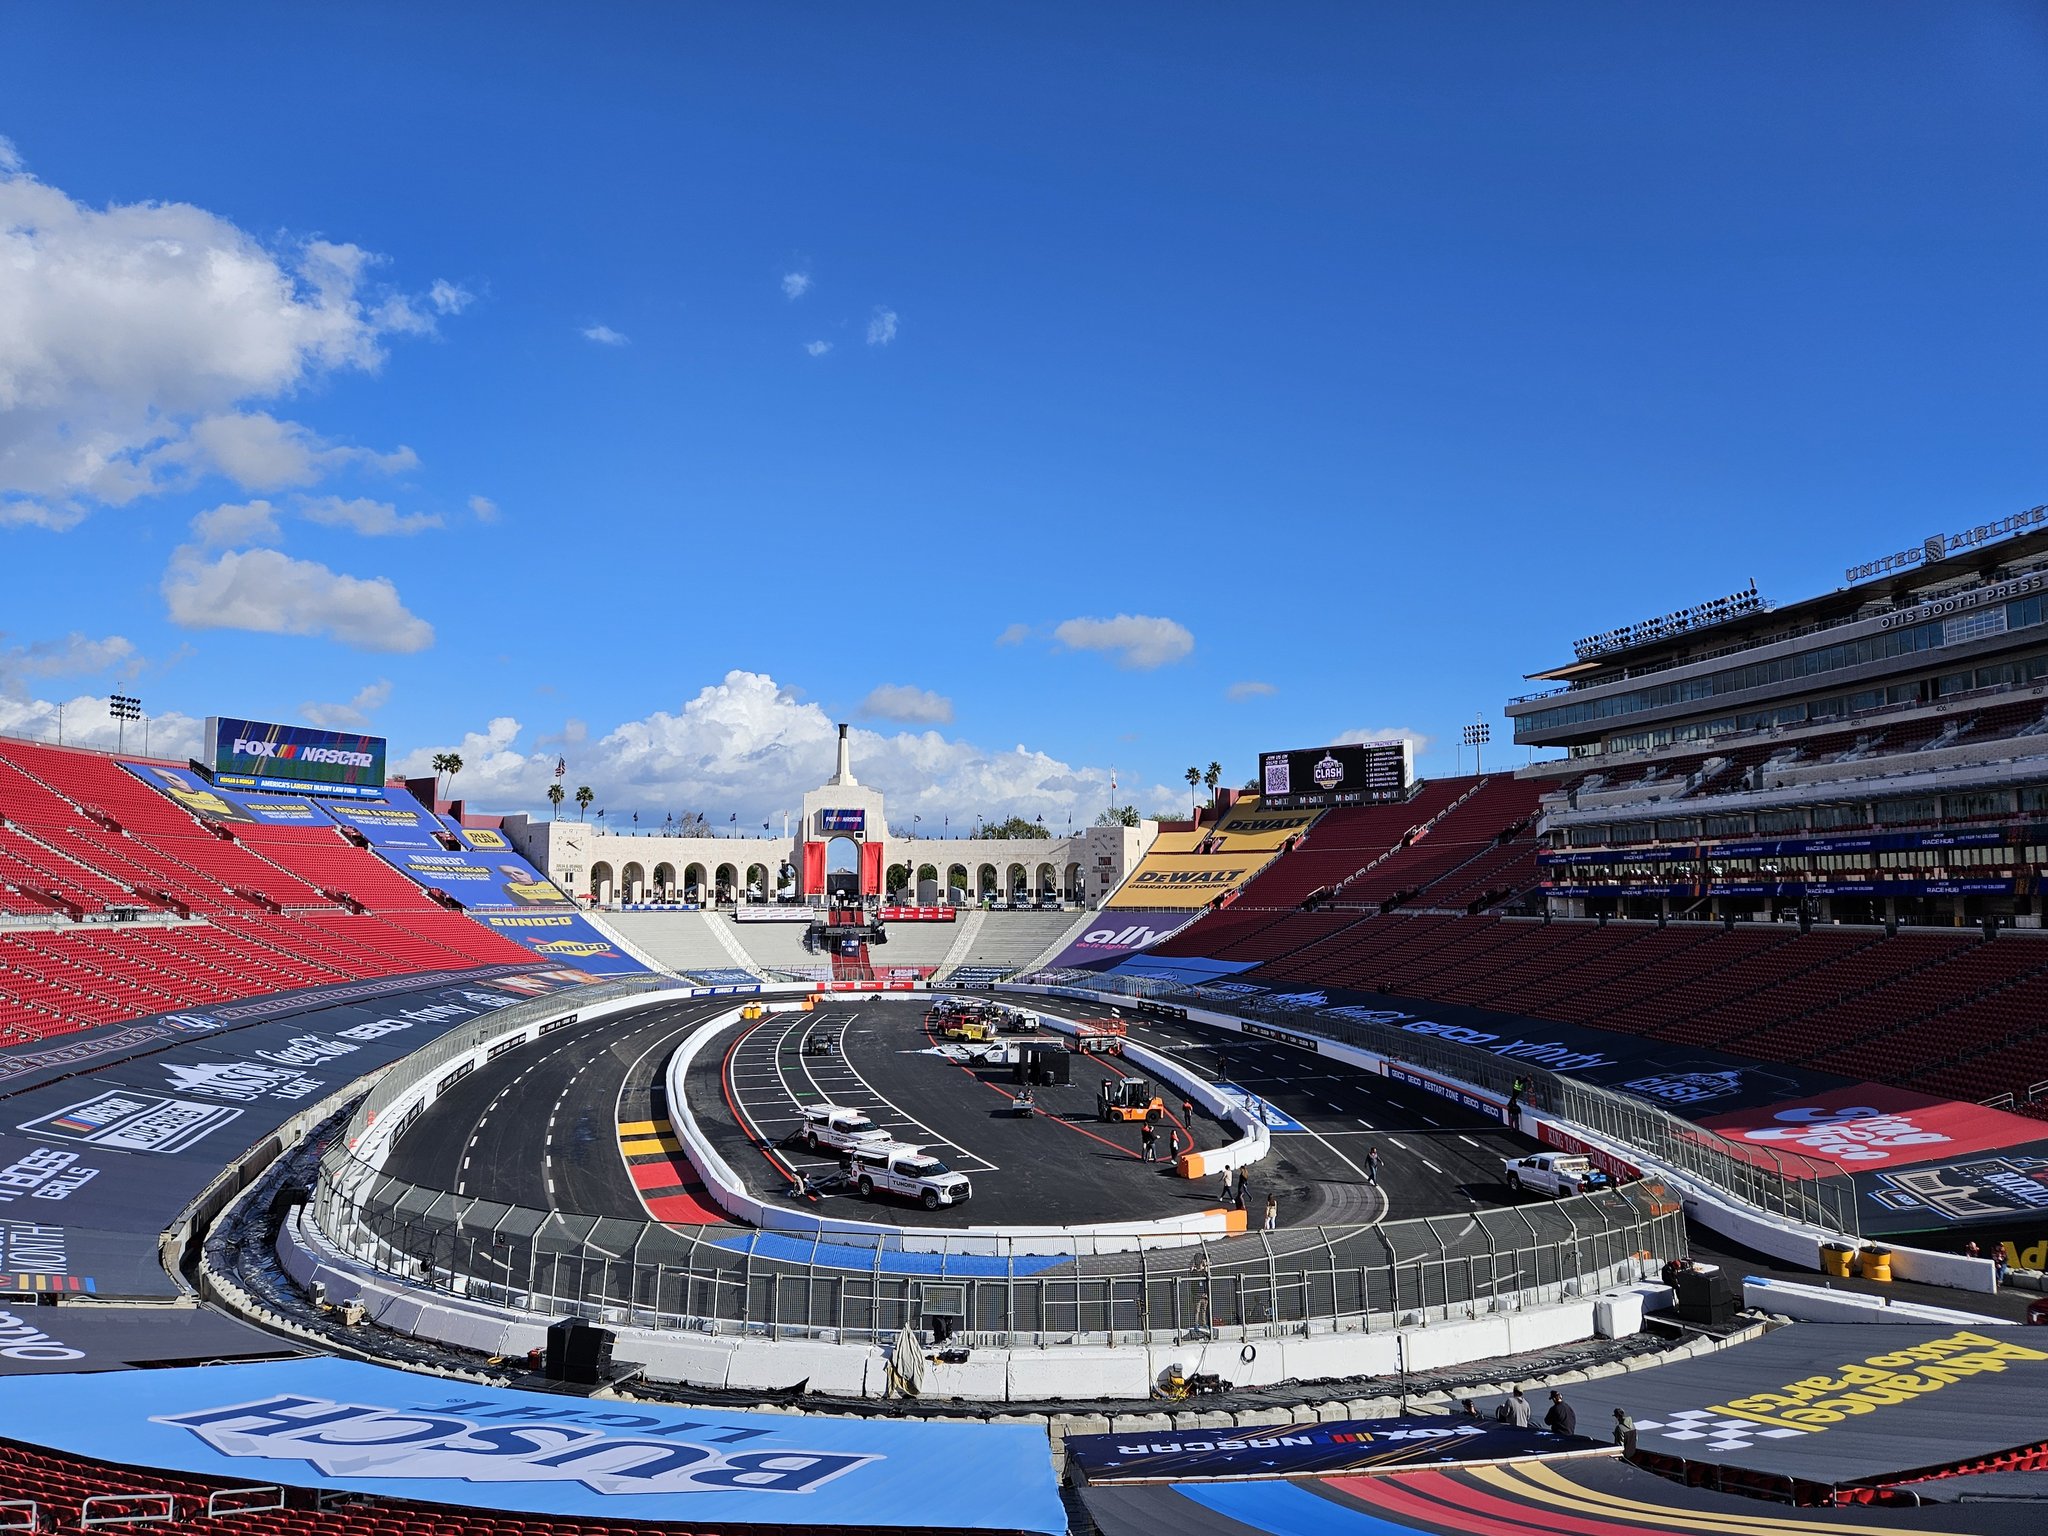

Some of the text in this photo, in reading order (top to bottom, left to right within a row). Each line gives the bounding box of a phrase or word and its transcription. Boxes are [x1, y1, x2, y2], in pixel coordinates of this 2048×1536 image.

[1846, 548, 1921, 582] UNITED
[1880, 576, 2043, 629] OTIS BOOTH PRESS
[2032, 687, 2044, 696] 407
[1935, 704, 1947, 712] 406
[233, 738, 373, 768] FOX NASCAR
[261, 780, 290, 789] AMERICA'S
[291, 782, 314, 790] LARGEST
[1315, 767, 1342, 779] CLASH
[1224, 816, 1311, 831] DEWALT
[472, 836, 499, 844] #LAW
[408, 855, 467, 865] INJURED?
[1134, 870, 1246, 883] DEWALT
[489, 916, 573, 926] SUNOCO
[536, 942, 608, 952] SUNOCO
[1084, 926, 1173, 949] ally
[694, 988, 712, 996] SUNOCO
[735, 985, 757, 993] SUNOCO
[399, 1004, 479, 1023] xfinity
[336, 1019, 413, 1040] GEICO
[1402, 1020, 1500, 1044] GEICO
[1490, 1039, 1618, 1072] xfinity
[186, 1061, 307, 1101] BUSCH
[269, 1077, 326, 1100] LIGHT
[1391, 1069, 1499, 1118] GEICO GEICO RESTART ZONE GEICO GEICO
[1623, 1078, 1718, 1103] CLASH
[76, 1098, 148, 1125] NASCAR
[117, 1107, 205, 1143] CUP SERIES
[1773, 1106, 1955, 1146] King
[831, 1135, 848, 1143] TUNDRA
[1548, 1127, 1582, 1154] KING TACO
[1744, 1120, 1890, 1160] Taco
[1590, 1147, 1627, 1181] KING TACO
[892, 1179, 917, 1189] TUNDRA
[8, 1225, 68, 1275] MONTH
[1864, 1331, 2001, 1368] Auto
[1727, 1363, 1898, 1413] Parts
[1780, 1342, 2048, 1424] Advance
[401, 1401, 773, 1444] LIGHT
[160, 1396, 884, 1492] BUSCH
[1118, 1425, 1488, 1454] FOX NASCAR
